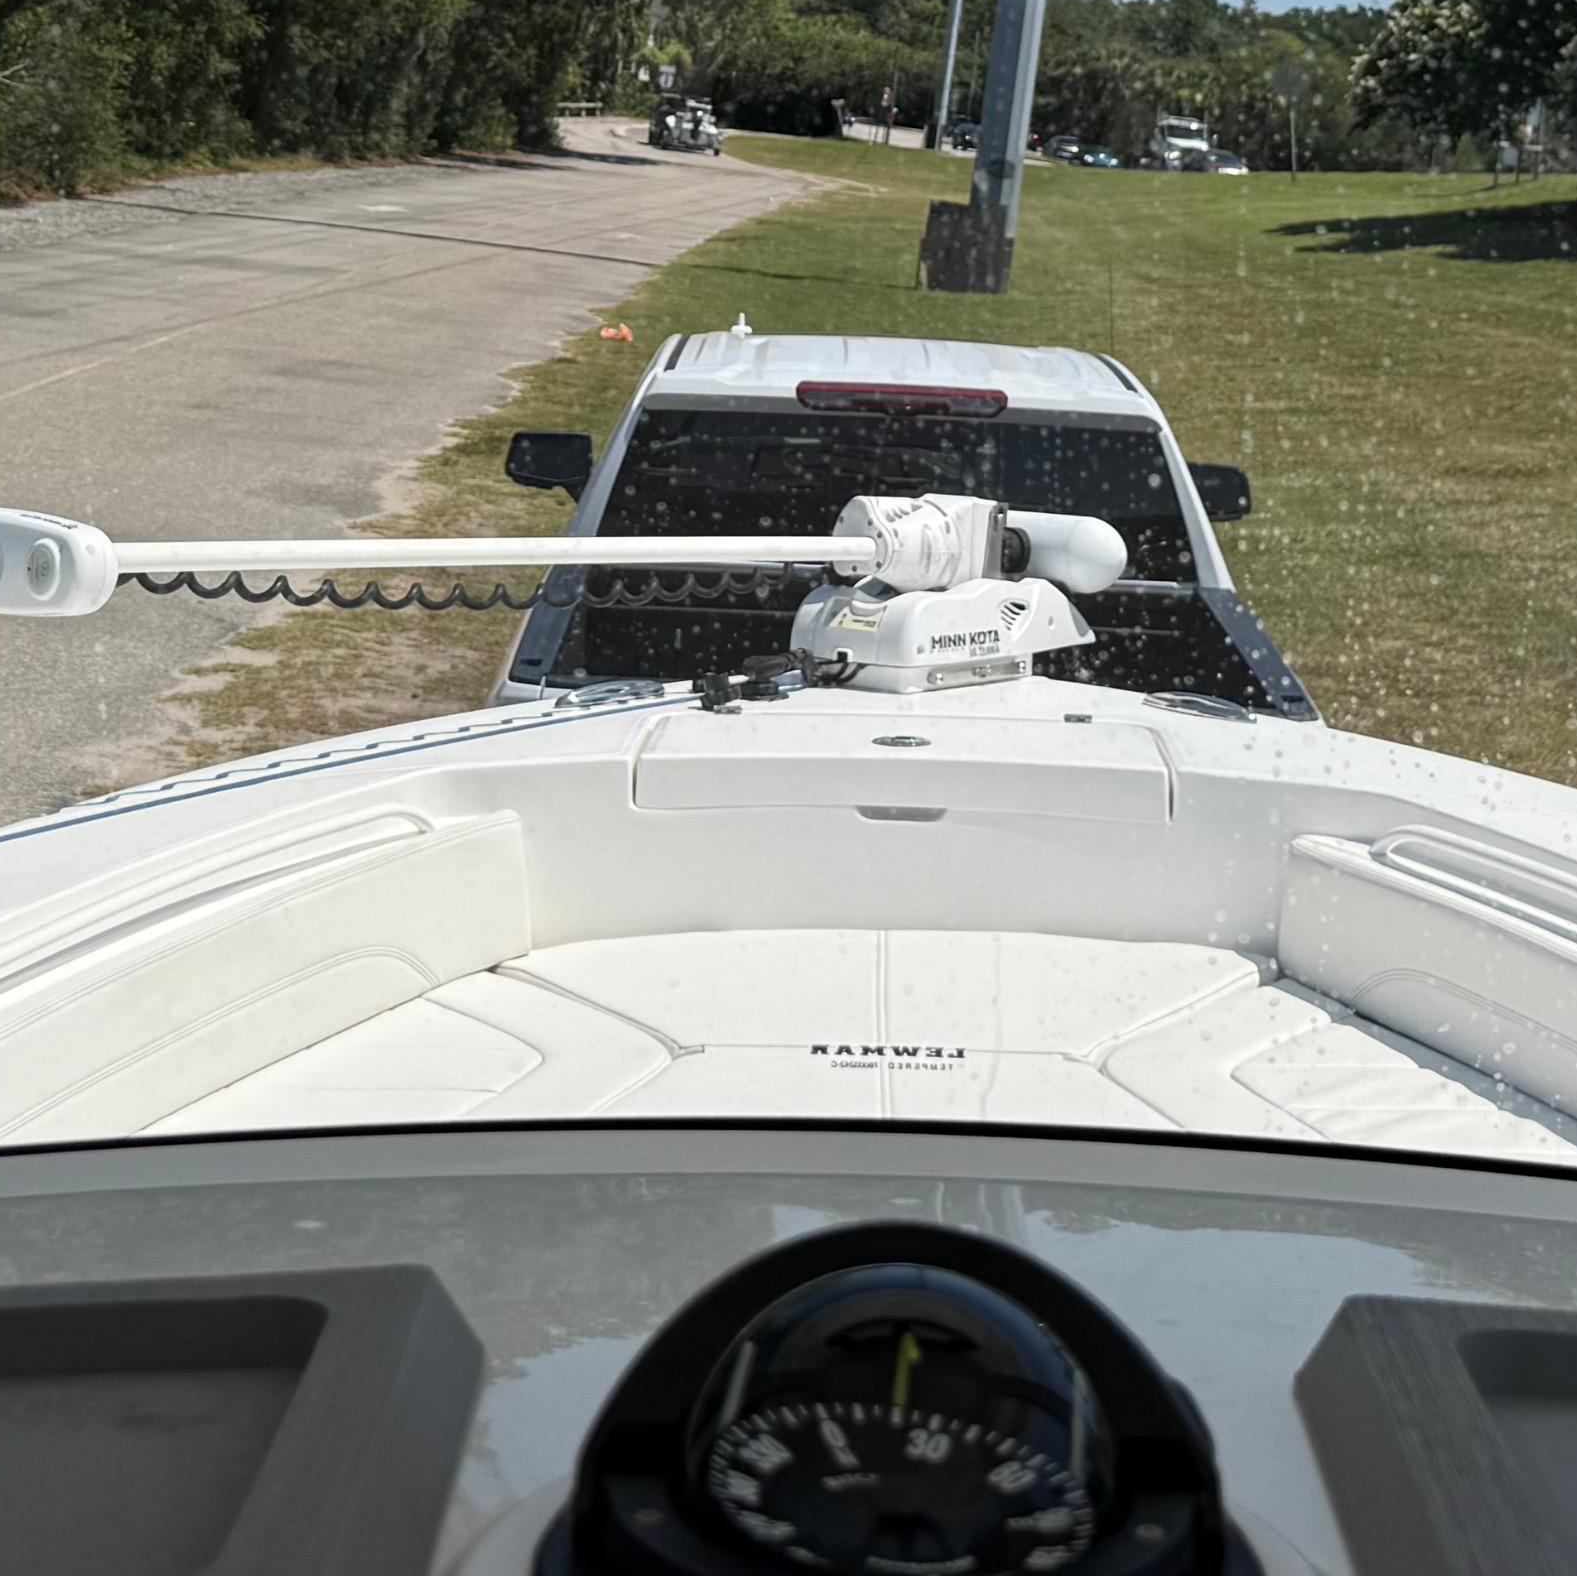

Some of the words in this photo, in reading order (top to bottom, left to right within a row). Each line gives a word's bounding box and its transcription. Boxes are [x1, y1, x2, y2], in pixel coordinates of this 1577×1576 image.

[931, 633, 966, 649] MINN
[968, 629, 1000, 646] KOTA
[904, 1428, 952, 1464] 30
